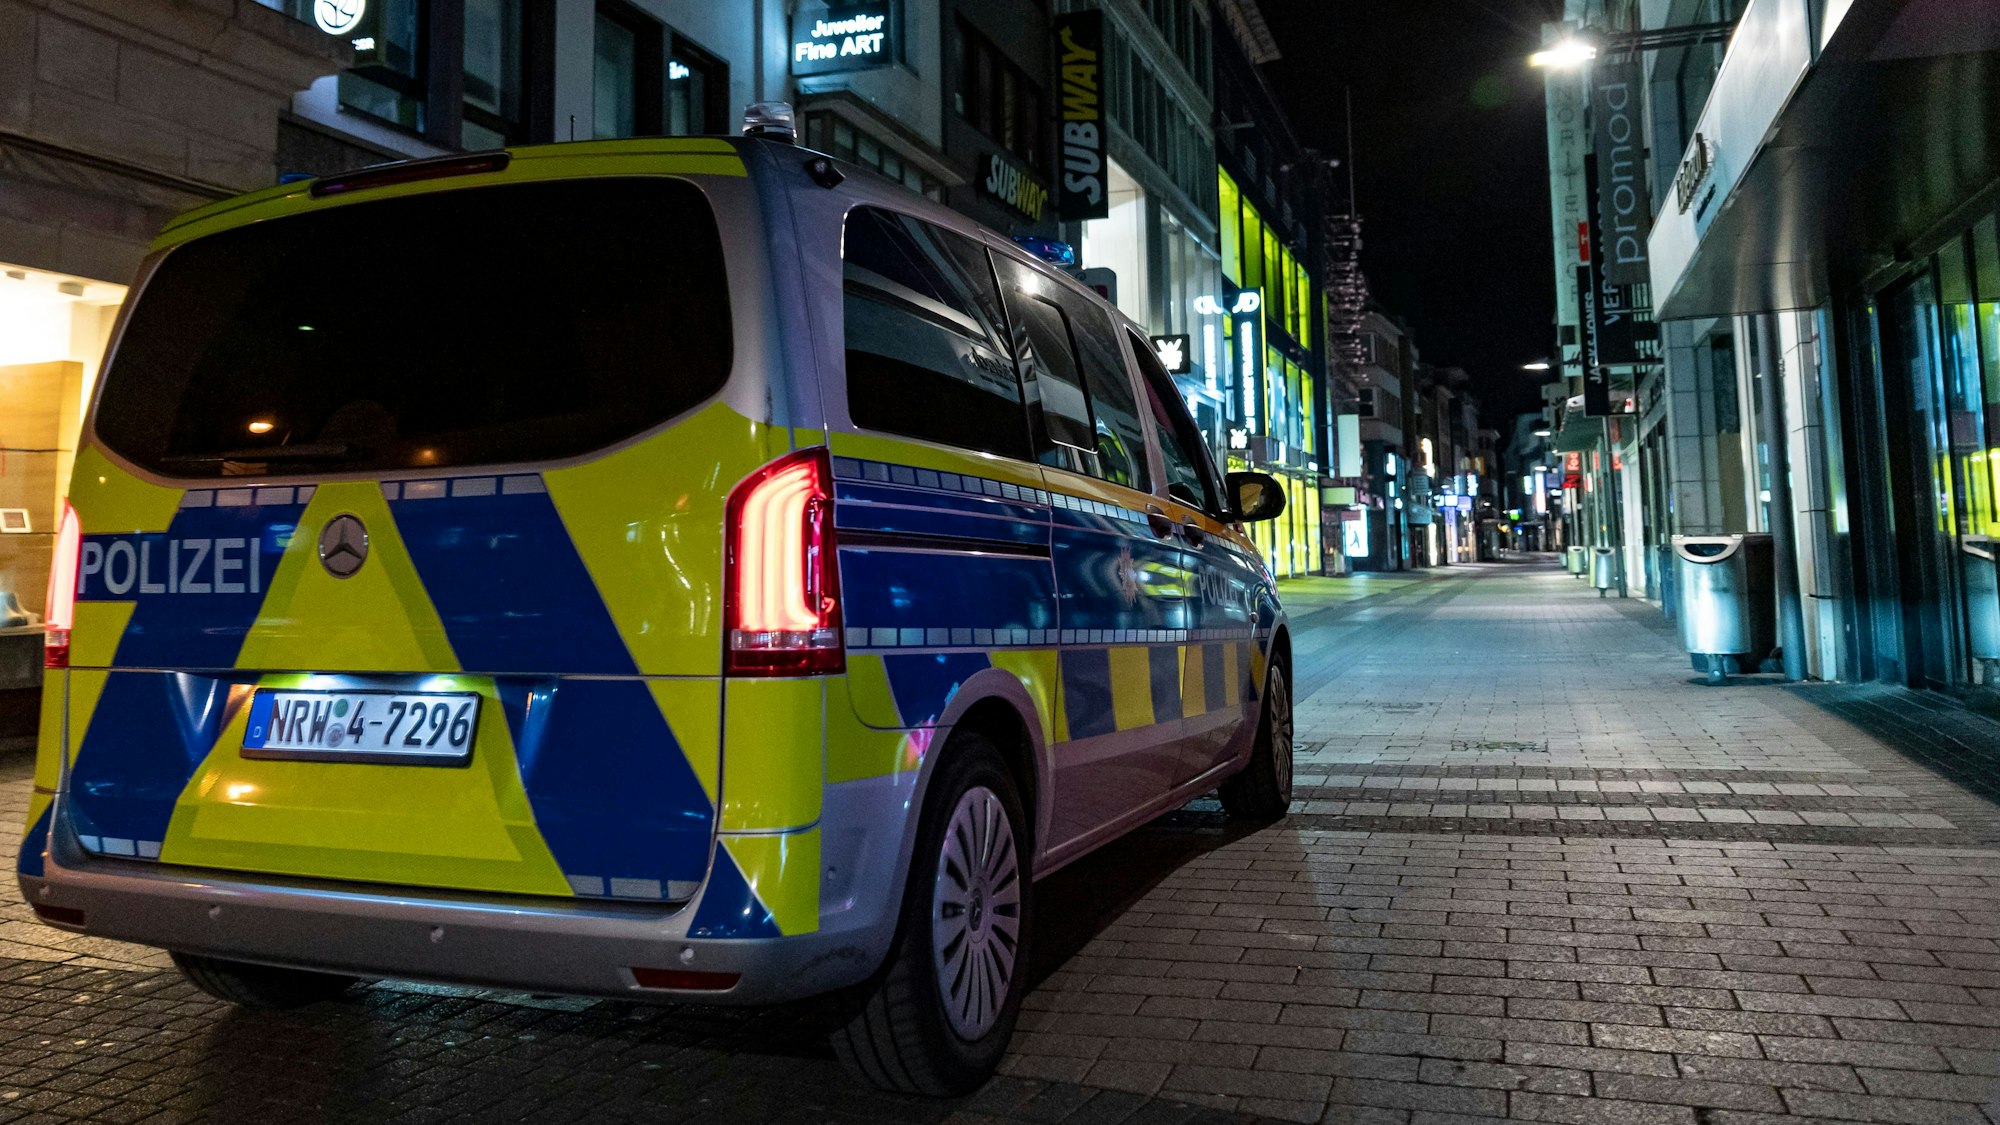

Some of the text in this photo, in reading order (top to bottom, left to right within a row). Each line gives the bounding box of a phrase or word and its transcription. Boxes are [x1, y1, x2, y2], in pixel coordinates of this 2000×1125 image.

[795, 33, 884, 62] Fine ART
[811, 14, 884, 38] Juwelier
[1059, 25, 1101, 206] SUBWAY
[986, 154, 1048, 222] SUBWAY
[1599, 83, 1647, 264] promod
[77, 537, 261, 595] POLIZEI
[266, 699, 473, 748] NRW 4-7296
